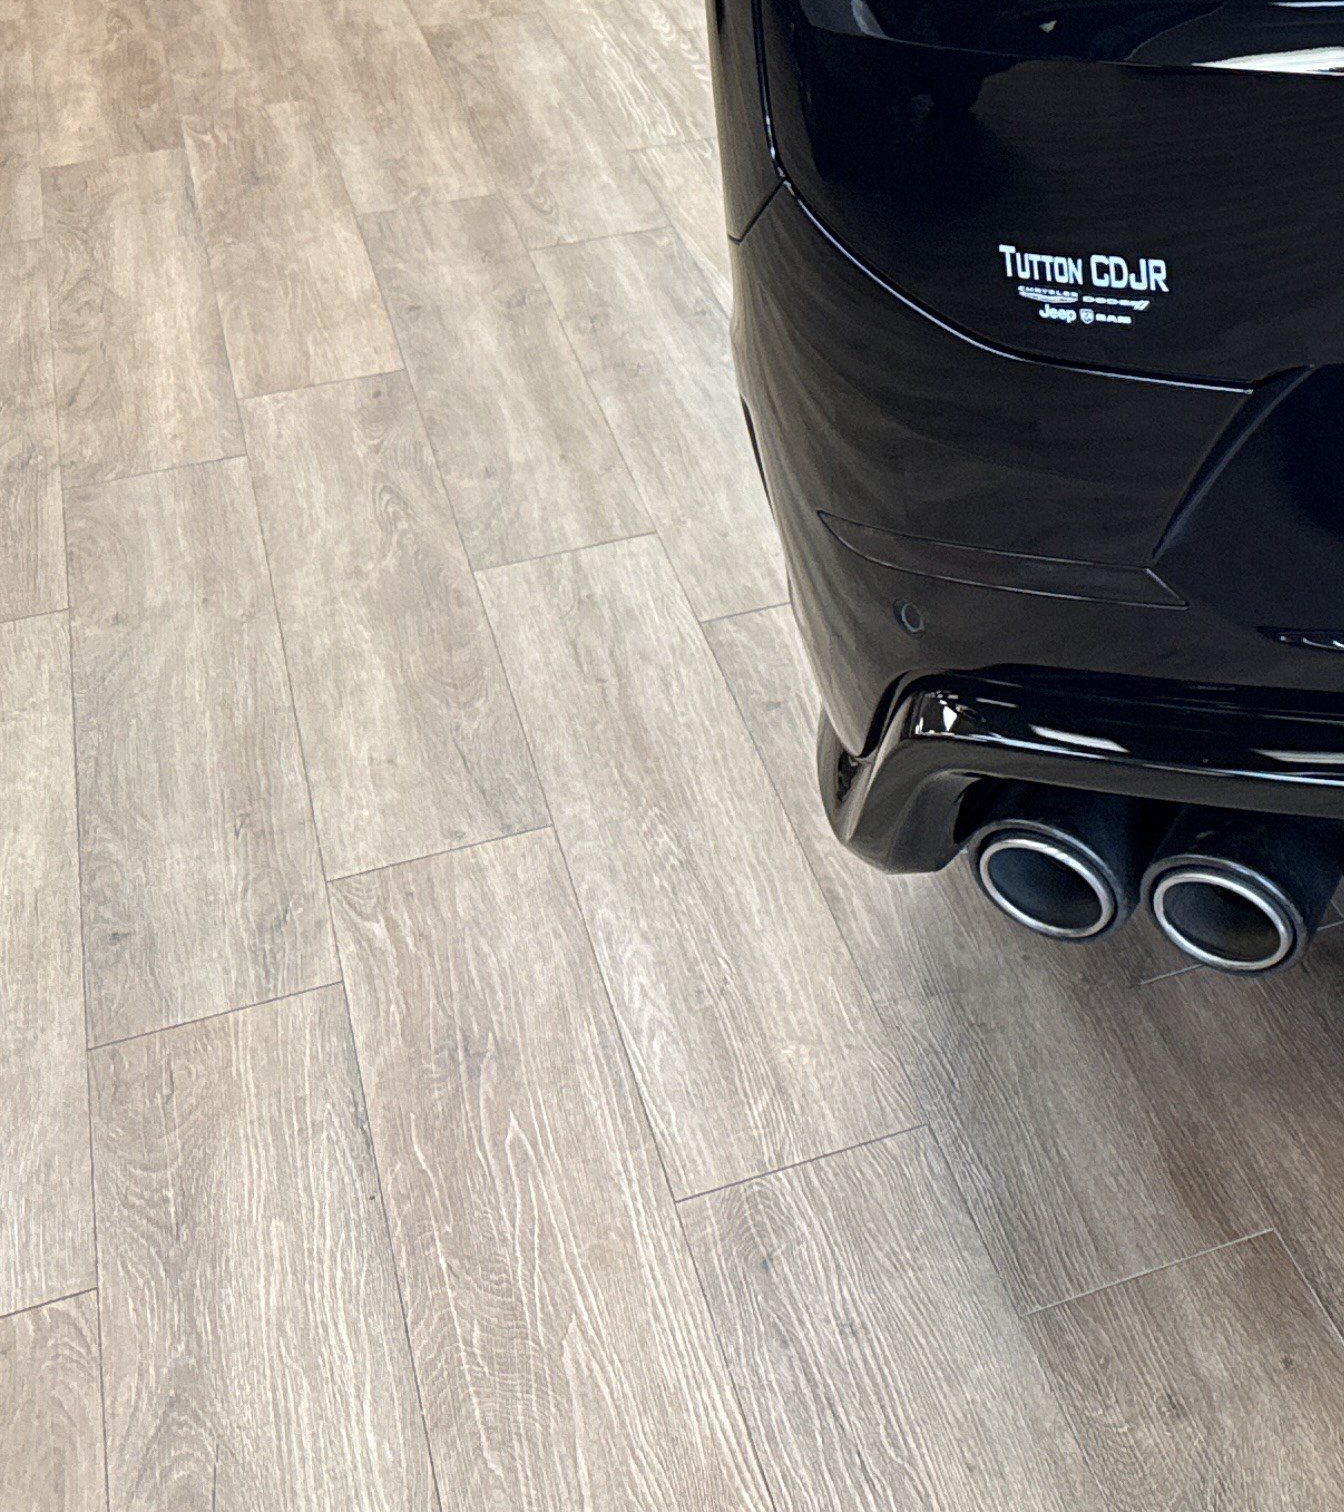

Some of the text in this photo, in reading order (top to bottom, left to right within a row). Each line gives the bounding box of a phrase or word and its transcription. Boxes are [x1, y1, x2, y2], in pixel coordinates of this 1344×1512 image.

[999, 244, 1170, 292] TUTTON CDJR
[1038, 303, 1076, 323] Jeep
